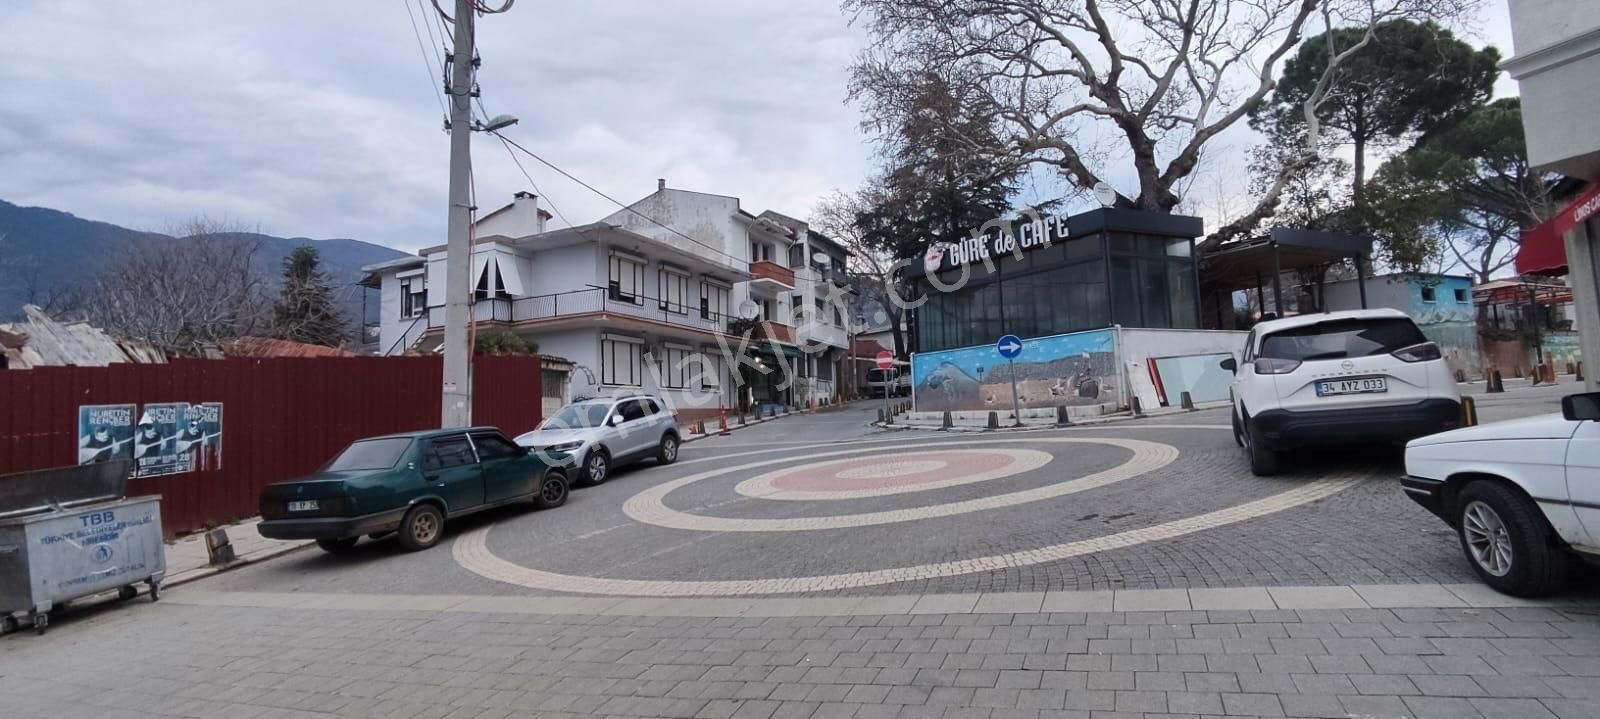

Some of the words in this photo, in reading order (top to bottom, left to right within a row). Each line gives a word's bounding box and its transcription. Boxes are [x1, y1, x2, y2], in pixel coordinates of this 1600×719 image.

[994, 230, 1015, 254] de
[1020, 213, 1069, 248] CAFE
[1323, 383, 1335, 393] 34
[1341, 381, 1360, 391] AYZ
[1363, 379, 1383, 390] 033
[80, 511, 115, 527] TBB
